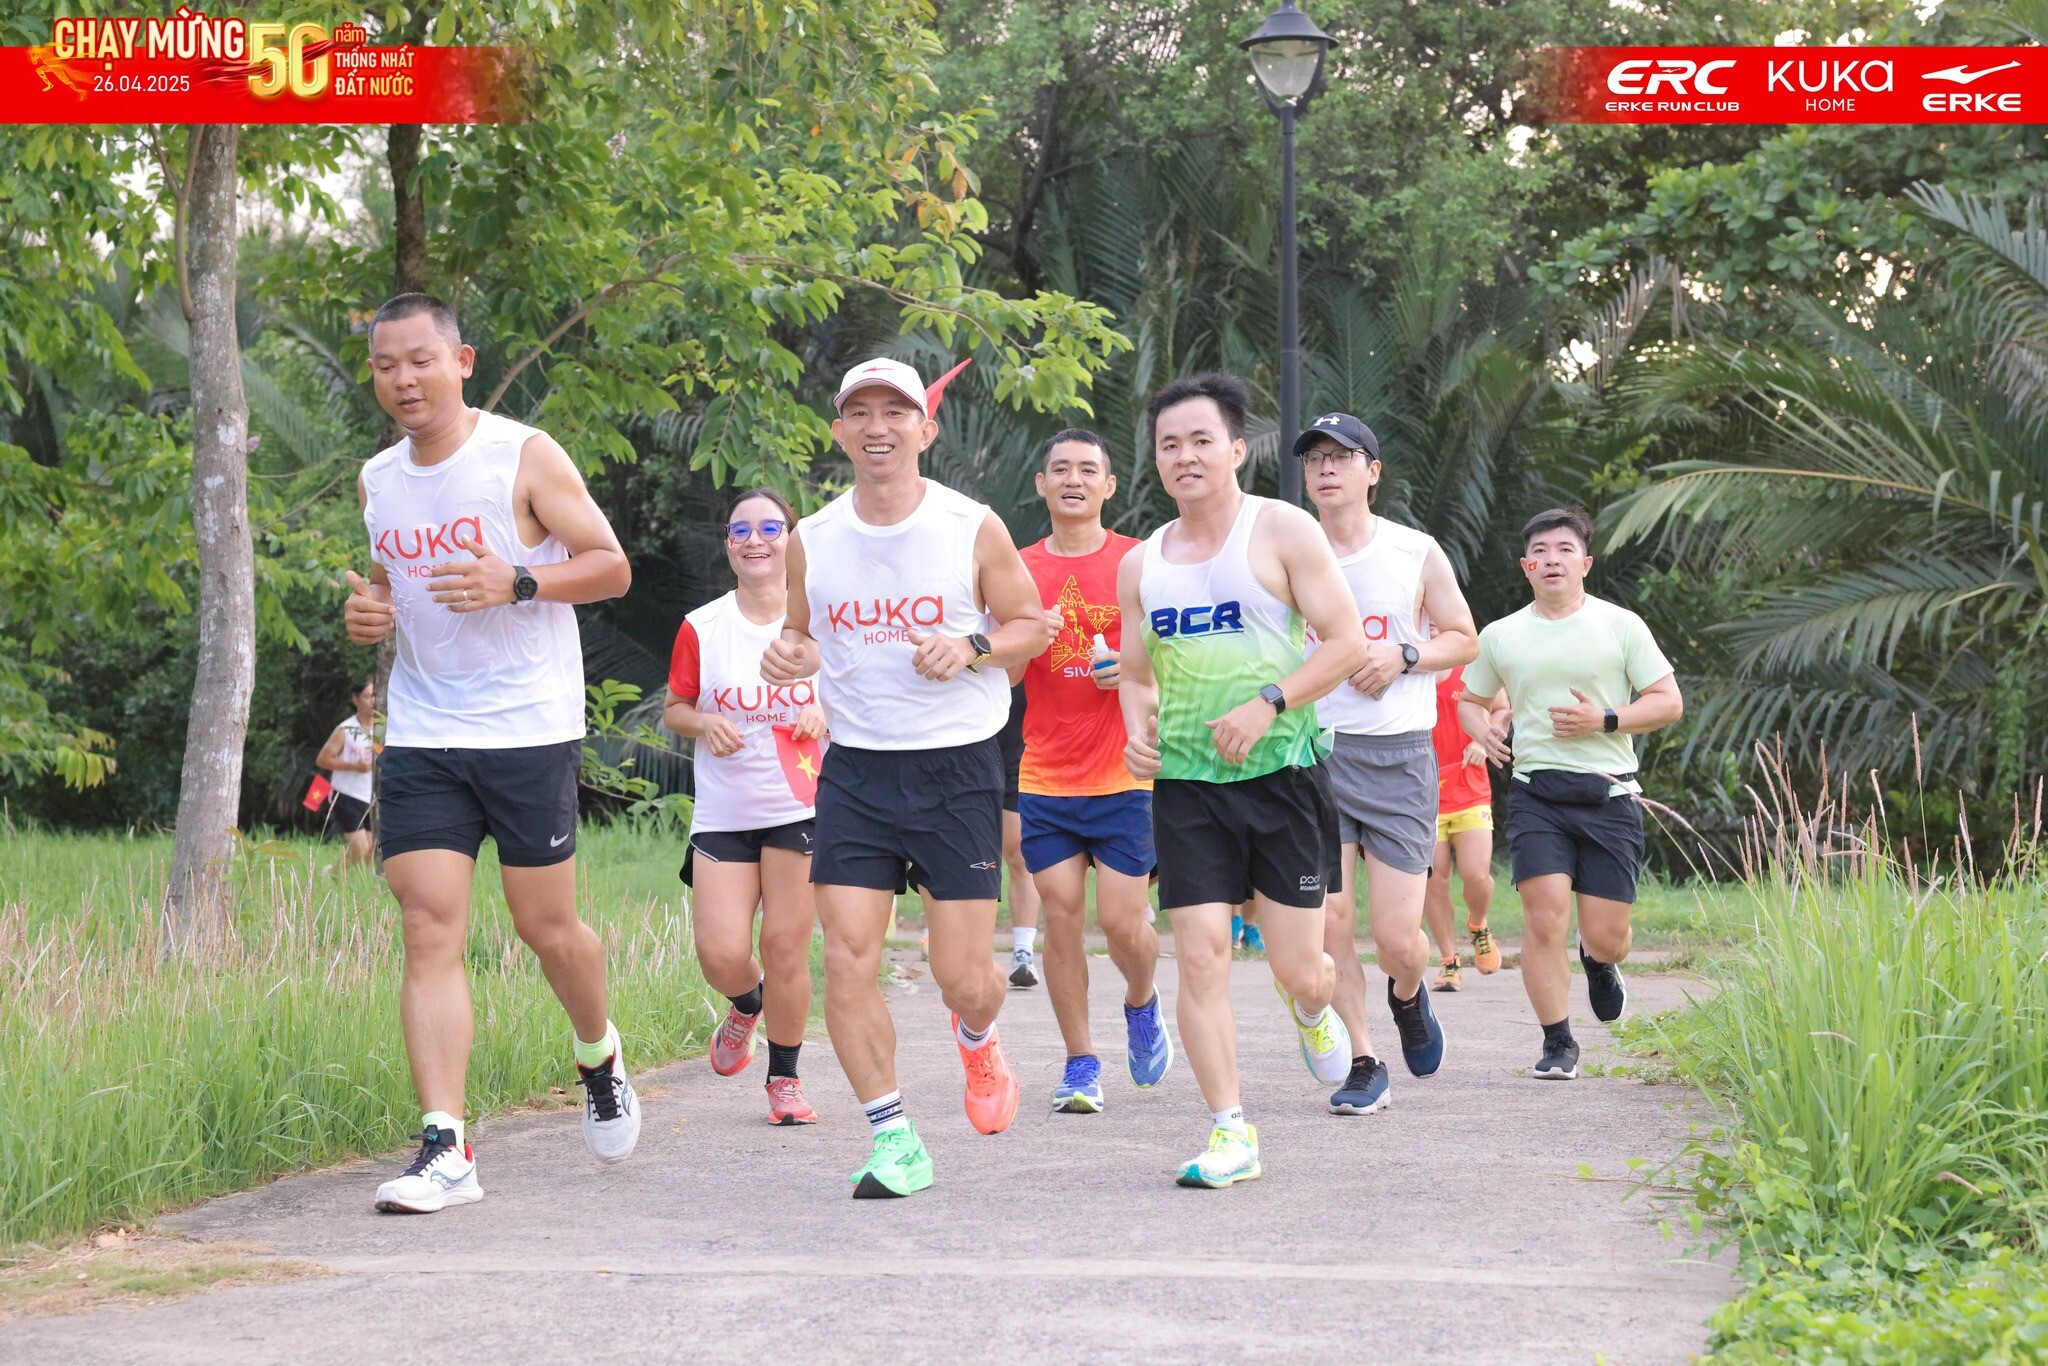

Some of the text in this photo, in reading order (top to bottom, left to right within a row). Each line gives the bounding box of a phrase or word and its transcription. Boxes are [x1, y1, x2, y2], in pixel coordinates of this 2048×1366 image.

[407, 561, 452, 578] HO
[1150, 600, 1245, 639] BCR
[863, 629, 911, 646] HOME
[1063, 665, 1092, 678] SIV
[745, 712, 787, 724] HOME
